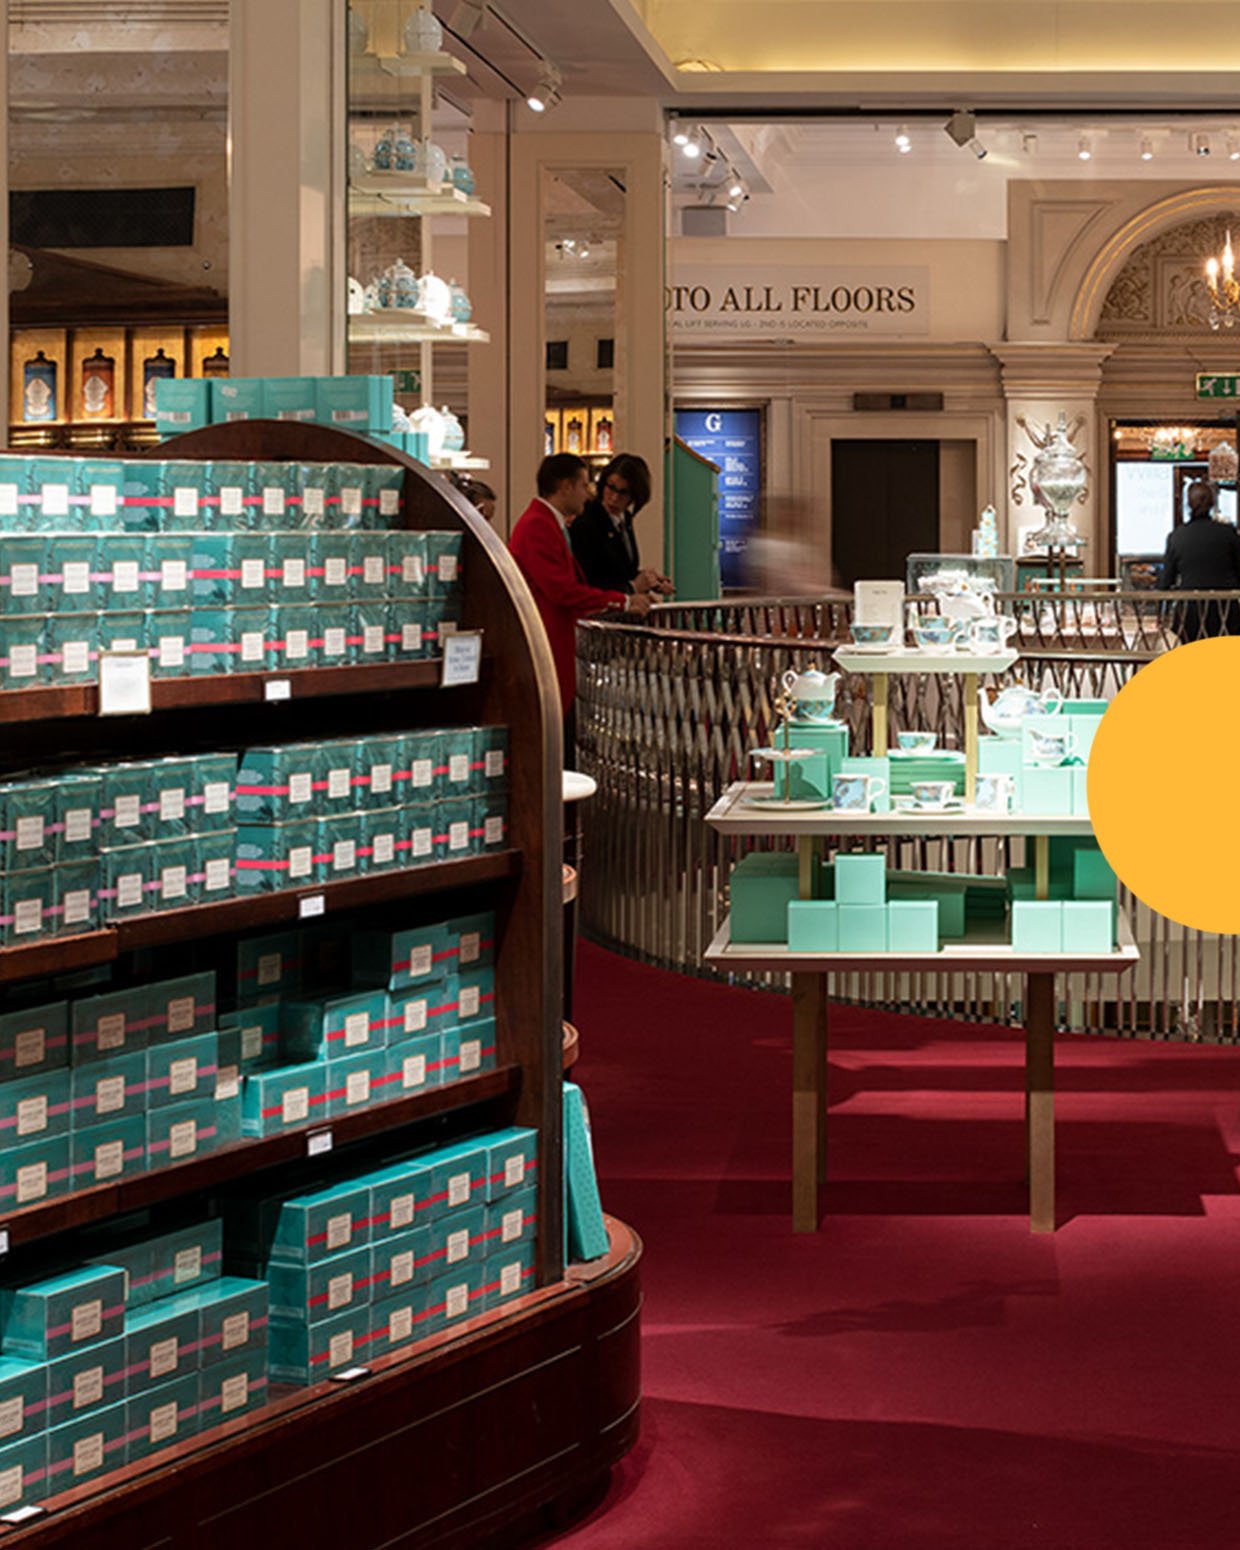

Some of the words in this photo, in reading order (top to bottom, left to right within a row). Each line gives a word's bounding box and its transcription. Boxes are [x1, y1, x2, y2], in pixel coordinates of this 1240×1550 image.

[673, 286, 711, 312] TO
[719, 286, 783, 312] ALL
[791, 285, 916, 313] FLOORS
[788, 320, 827, 329] LOCATED
[705, 413, 722, 432] G
